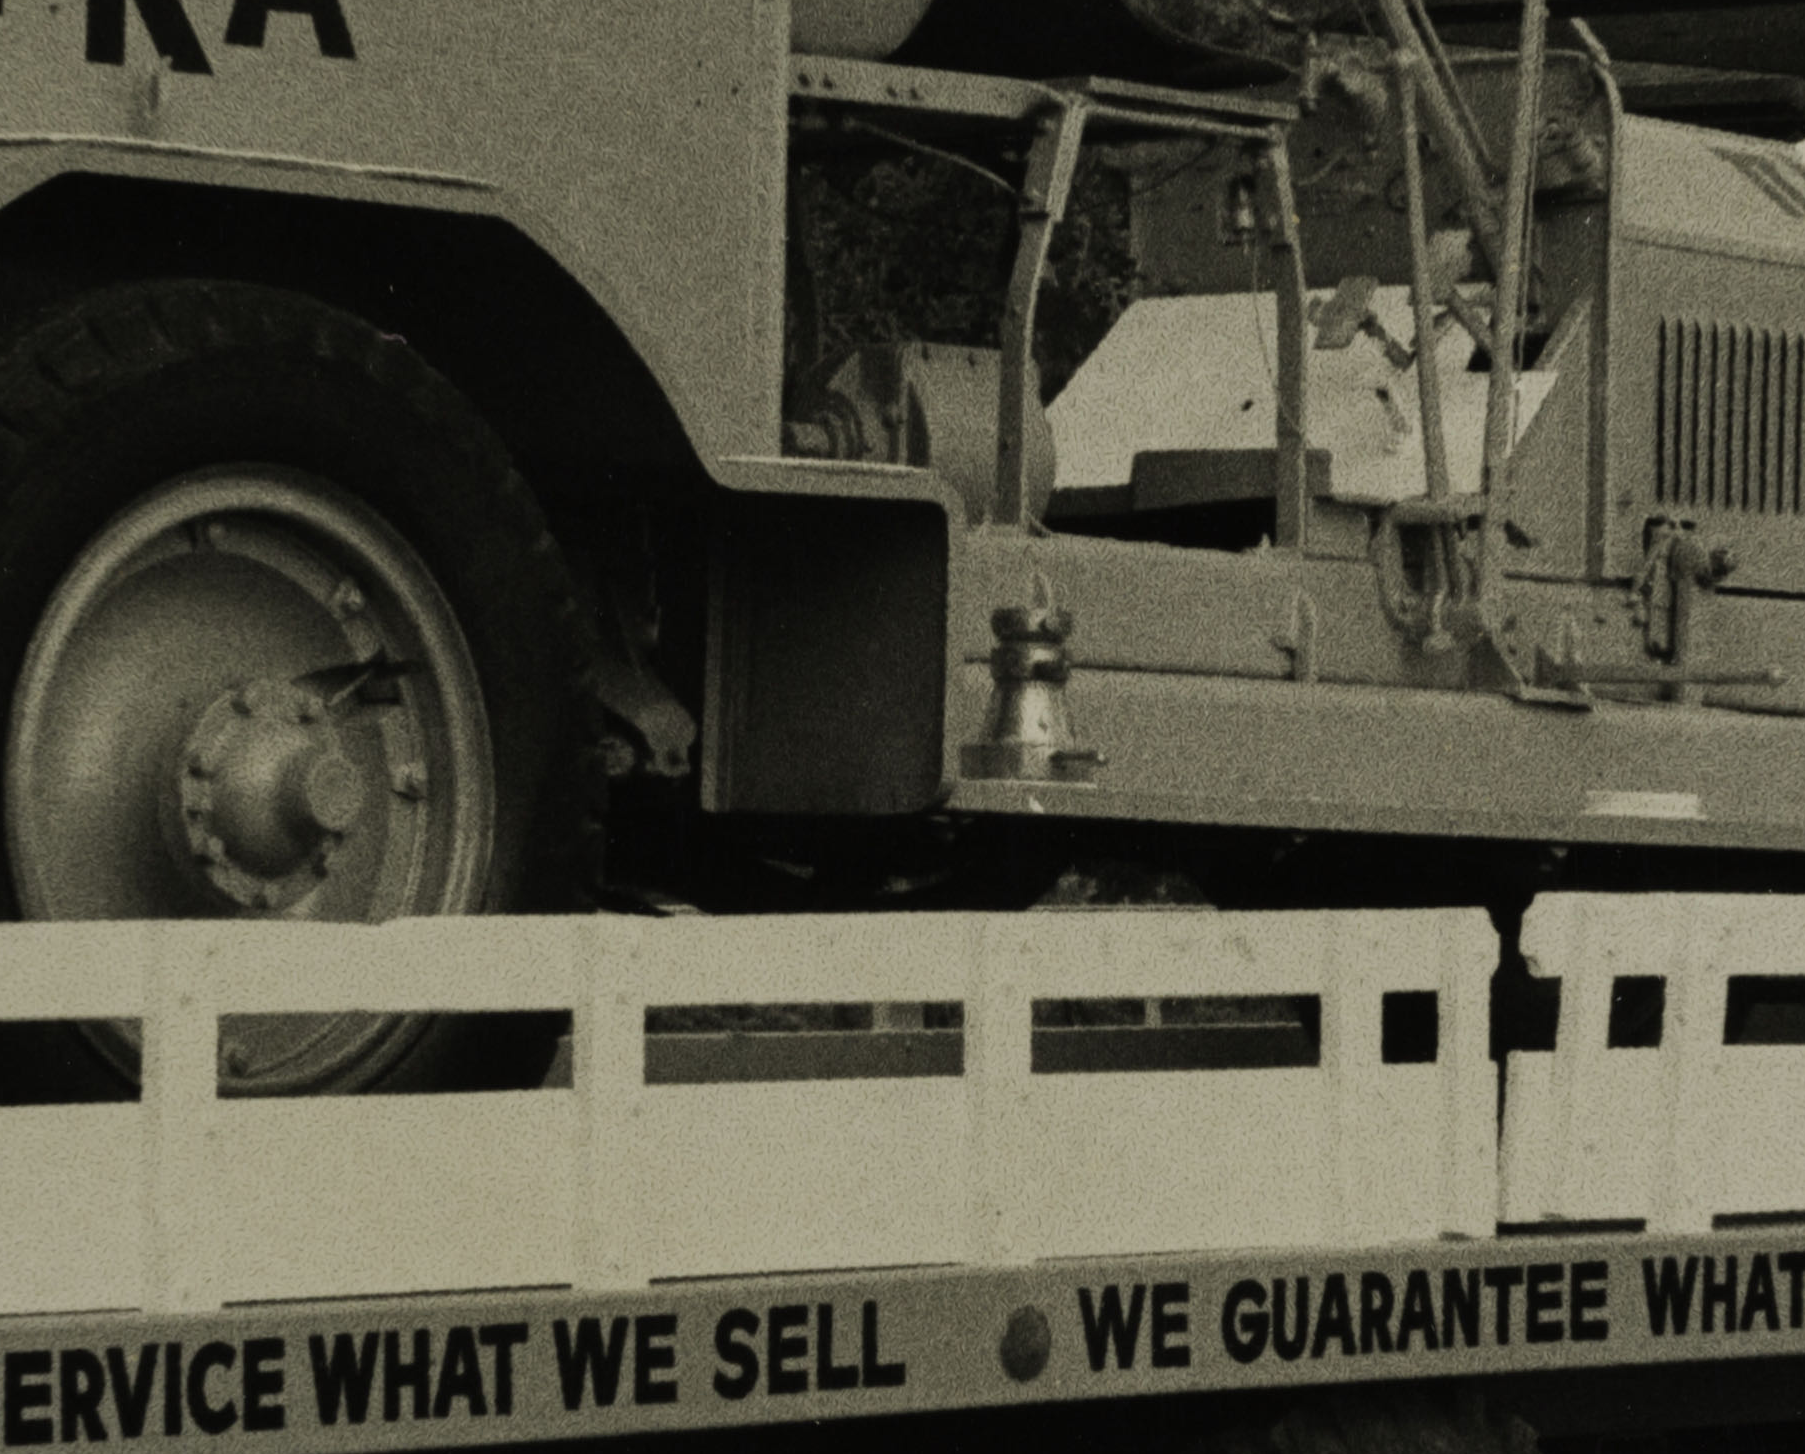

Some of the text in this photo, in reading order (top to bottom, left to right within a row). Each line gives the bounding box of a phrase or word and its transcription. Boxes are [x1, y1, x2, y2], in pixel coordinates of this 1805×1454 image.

[309, 1321, 529, 1426] WHAT
[552, 1313, 678, 1411] WE
[712, 1299, 906, 1401] SELL
[1077, 1280, 1191, 1373] WE
[1220, 1260, 1609, 1365] GUARANTEE
